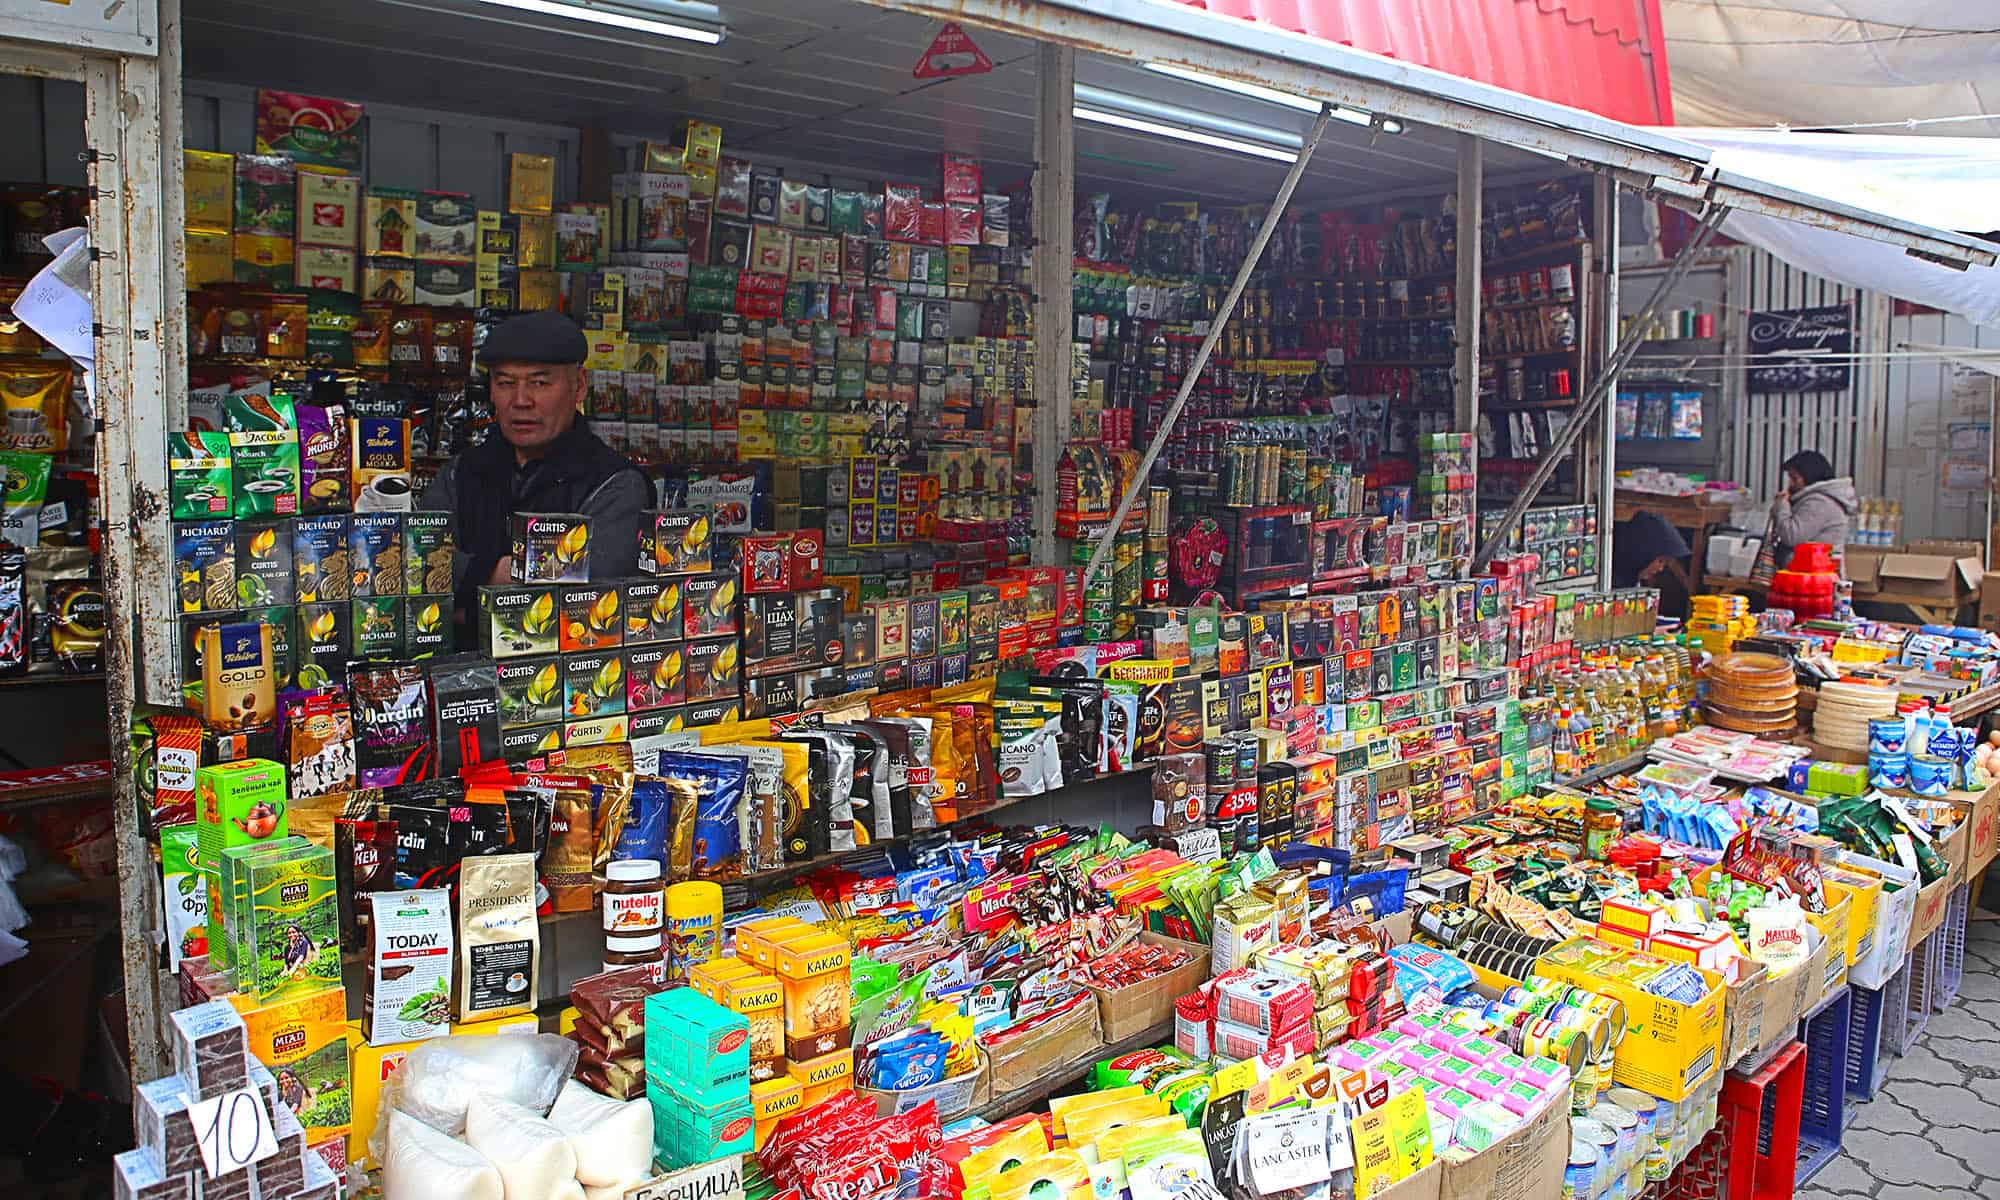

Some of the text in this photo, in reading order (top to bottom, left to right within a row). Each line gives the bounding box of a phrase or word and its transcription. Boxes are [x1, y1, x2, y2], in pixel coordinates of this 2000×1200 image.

[648, 181, 683, 191] TUDOR
[565, 219, 591, 230] TUDOR
[650, 260, 684, 271] TUDOR
[351, 399, 397, 413] Jardin
[248, 431, 286, 443] JACOBS
[369, 453, 393, 461] GOLD
[366, 460, 397, 468] MOKKA
[1, 518, 23, 529] оза
[298, 521, 341, 531] RICHARD
[354, 517, 395, 526] RICHARD
[407, 517, 447, 526] RICHARD
[533, 521, 568, 533] CURTIS
[660, 516, 690, 527] CURTIS
[181, 526, 229, 537] RICHARD
[251, 561, 278, 570] CURTIS
[628, 584, 659, 596] CURTIS
[689, 579, 717, 591] CURTIS
[496, 593, 531, 606] CURTIS
[565, 591, 599, 603] CURTIS
[766, 610, 795, 624] ШАХ
[360, 631, 397, 641] RICHARD
[416, 634, 442, 644] CURTIS
[311, 644, 338, 654] CURTIS
[690, 645, 719, 656] CURTIS
[631, 652, 662, 664] CURTIS
[569, 659, 601, 672] CURTIS
[219, 668, 266, 683] GOLD
[500, 666, 536, 679] CURTIS
[766, 689, 795, 704] ШАХ
[369, 703, 424, 725] Jardin
[441, 703, 496, 720] EGOISTE
[692, 708, 721, 720] CURTIS
[633, 716, 665, 730] CURTIS
[571, 725, 603, 738] CURTIS
[504, 733, 539, 746] CURTIS
[1000, 743, 1036, 754] LICANO
[162, 751, 188, 765] ROYAL
[159, 772, 188, 786] COFFEE
[907, 768, 930, 782] EME
[231, 779, 282, 796] Зелёный чай
[1226, 789, 1258, 811] -35%
[397, 832, 426, 850] rdin
[468, 894, 529, 908] PRESIDENT
[612, 895, 659, 910] nutella
[776, 902, 811, 919] ЕЛАТИН
[387, 933, 439, 950] TODAY
[475, 942, 529, 953] КОФЕ МОЛОТЫЙ
[807, 954, 844, 974] КАКАО
[739, 991, 778, 1009] КАКАО
[809, 1062, 847, 1083] КАКАО
[898, 1071, 931, 1089] VEGETA
[764, 1093, 799, 1115] КАКАО
[202, 1092, 260, 1178] 10
[1208, 1121, 1239, 1145] LANCAST
[1253, 1143, 1321, 1169] LANCASTER
